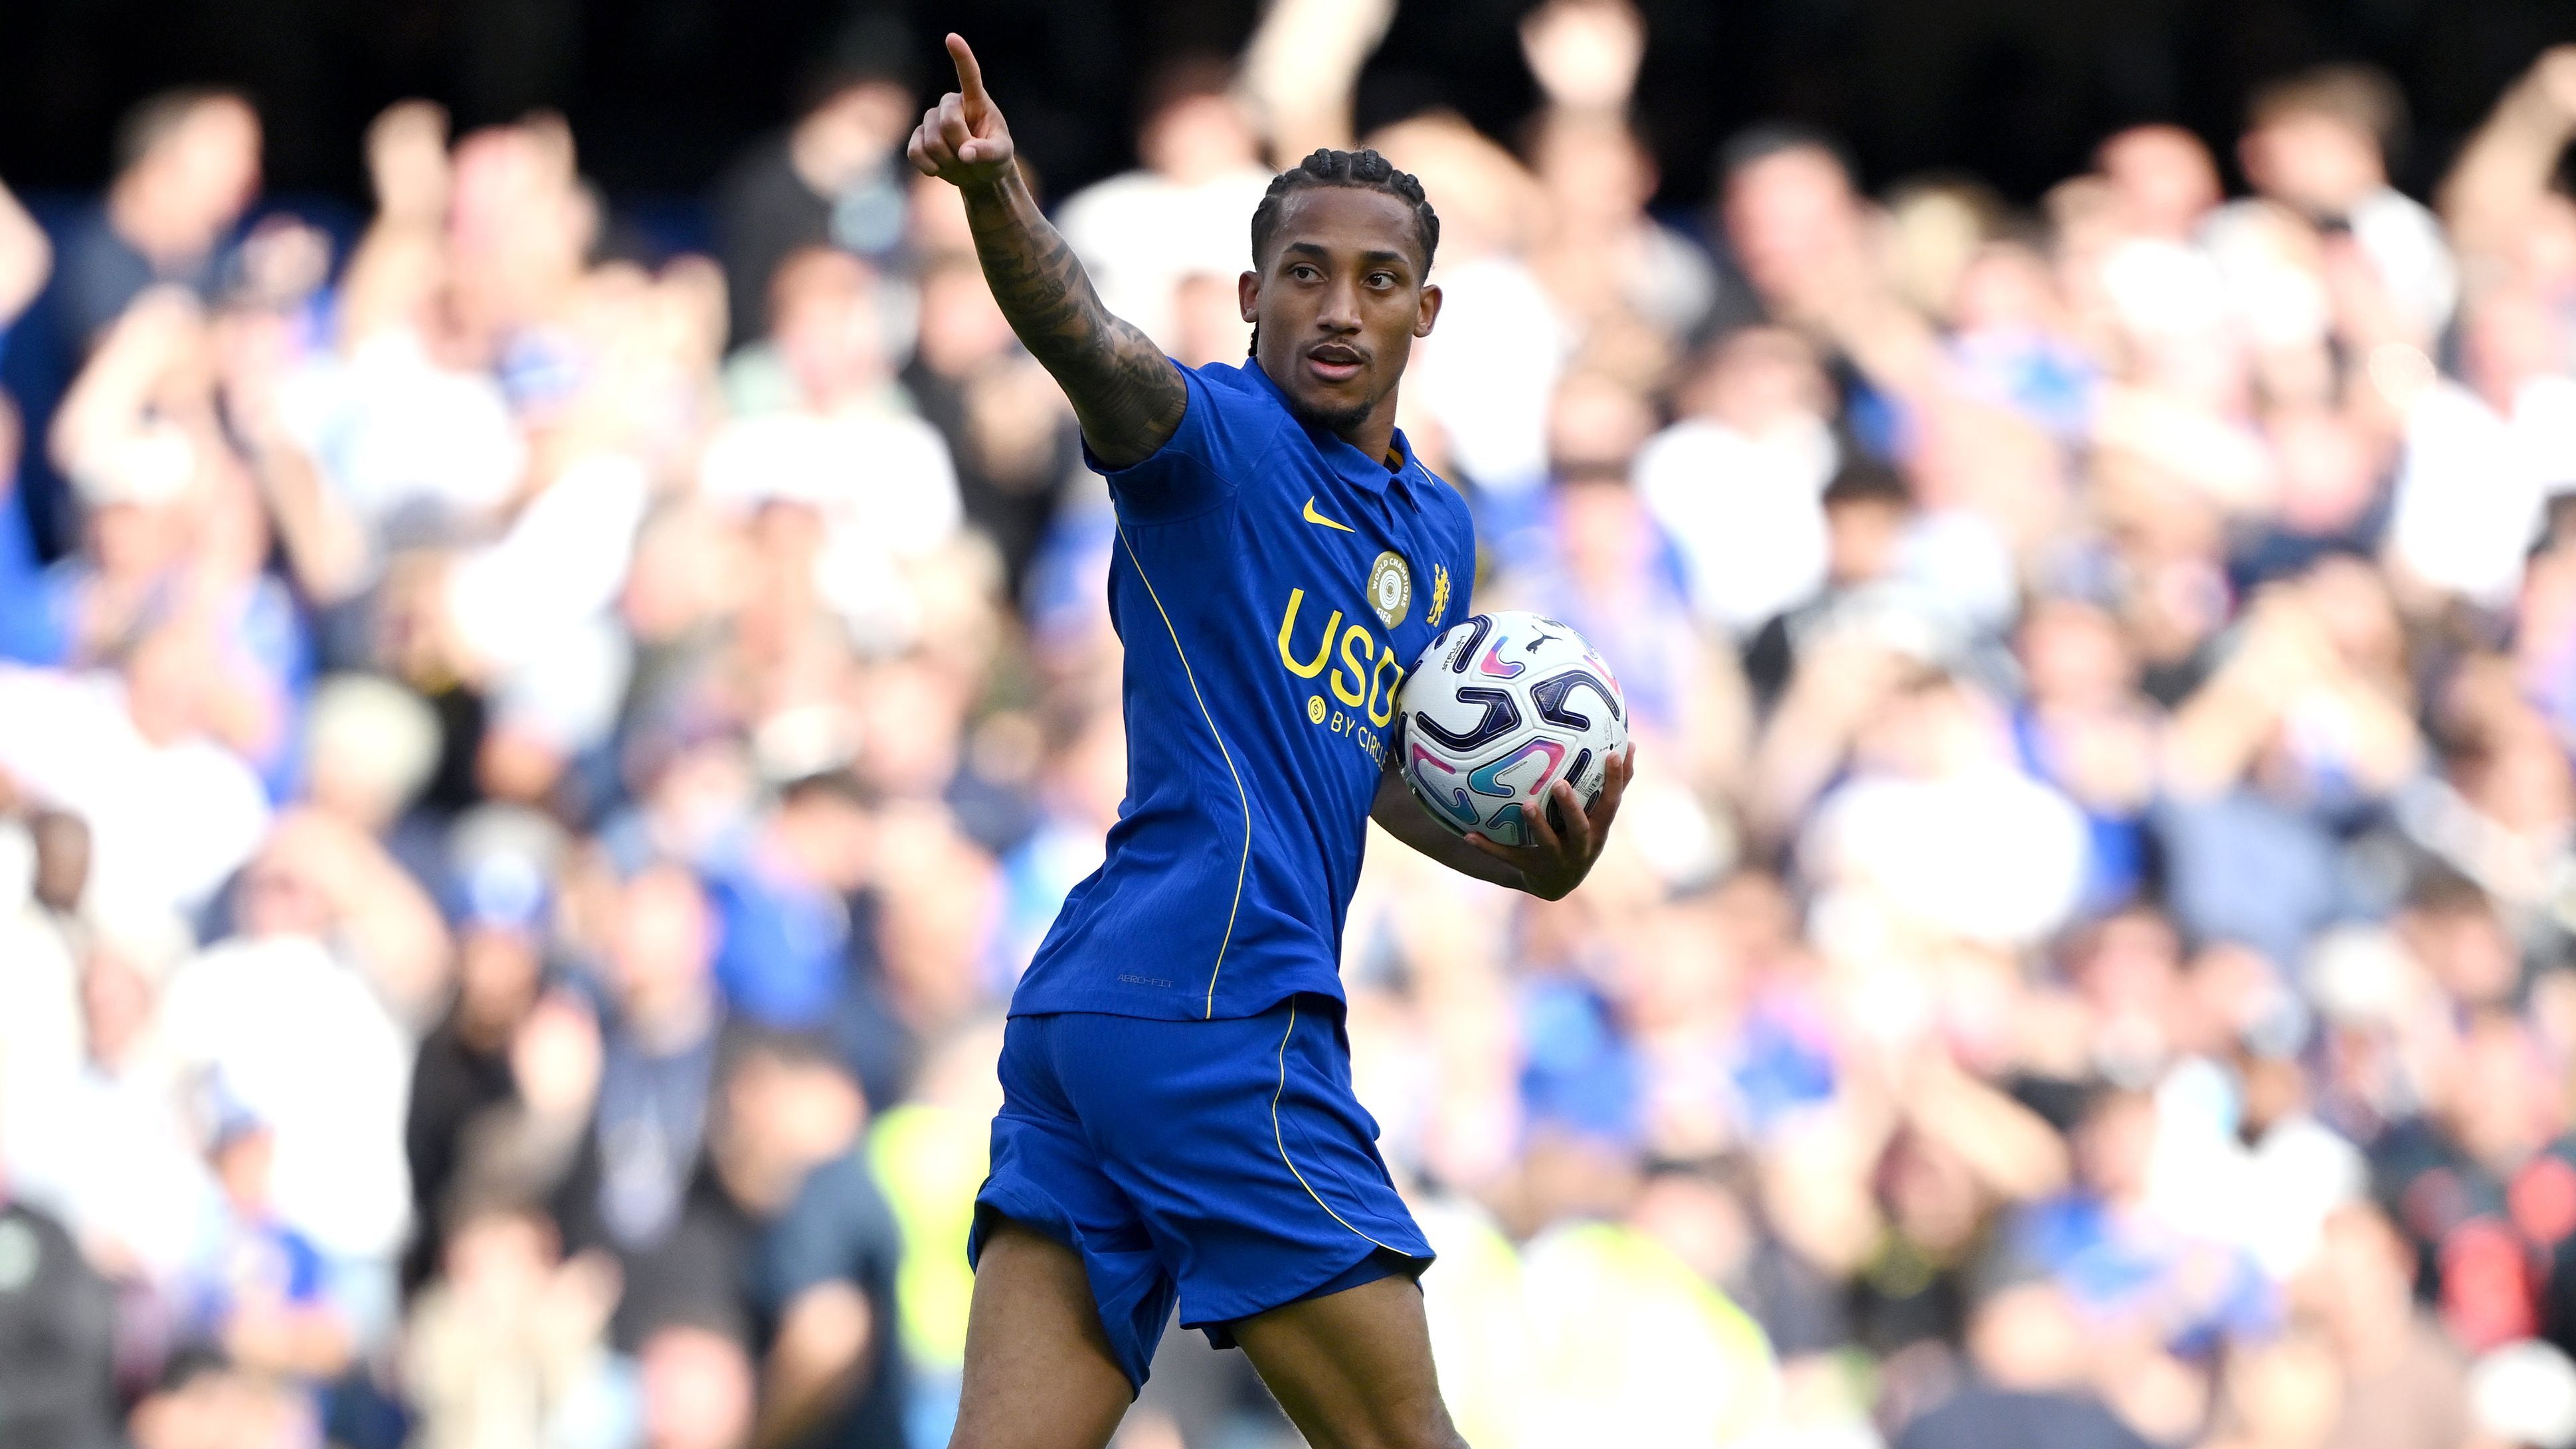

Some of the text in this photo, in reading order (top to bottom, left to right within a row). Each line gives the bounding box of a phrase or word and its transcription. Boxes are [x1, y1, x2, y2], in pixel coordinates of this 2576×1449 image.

[1372, 558, 1408, 608] WORLD CHAMPIONS
[1376, 607, 1392, 624] FIFA
[1331, 711, 1355, 738] BY
[1117, 974, 1174, 987] AERO-FIT
